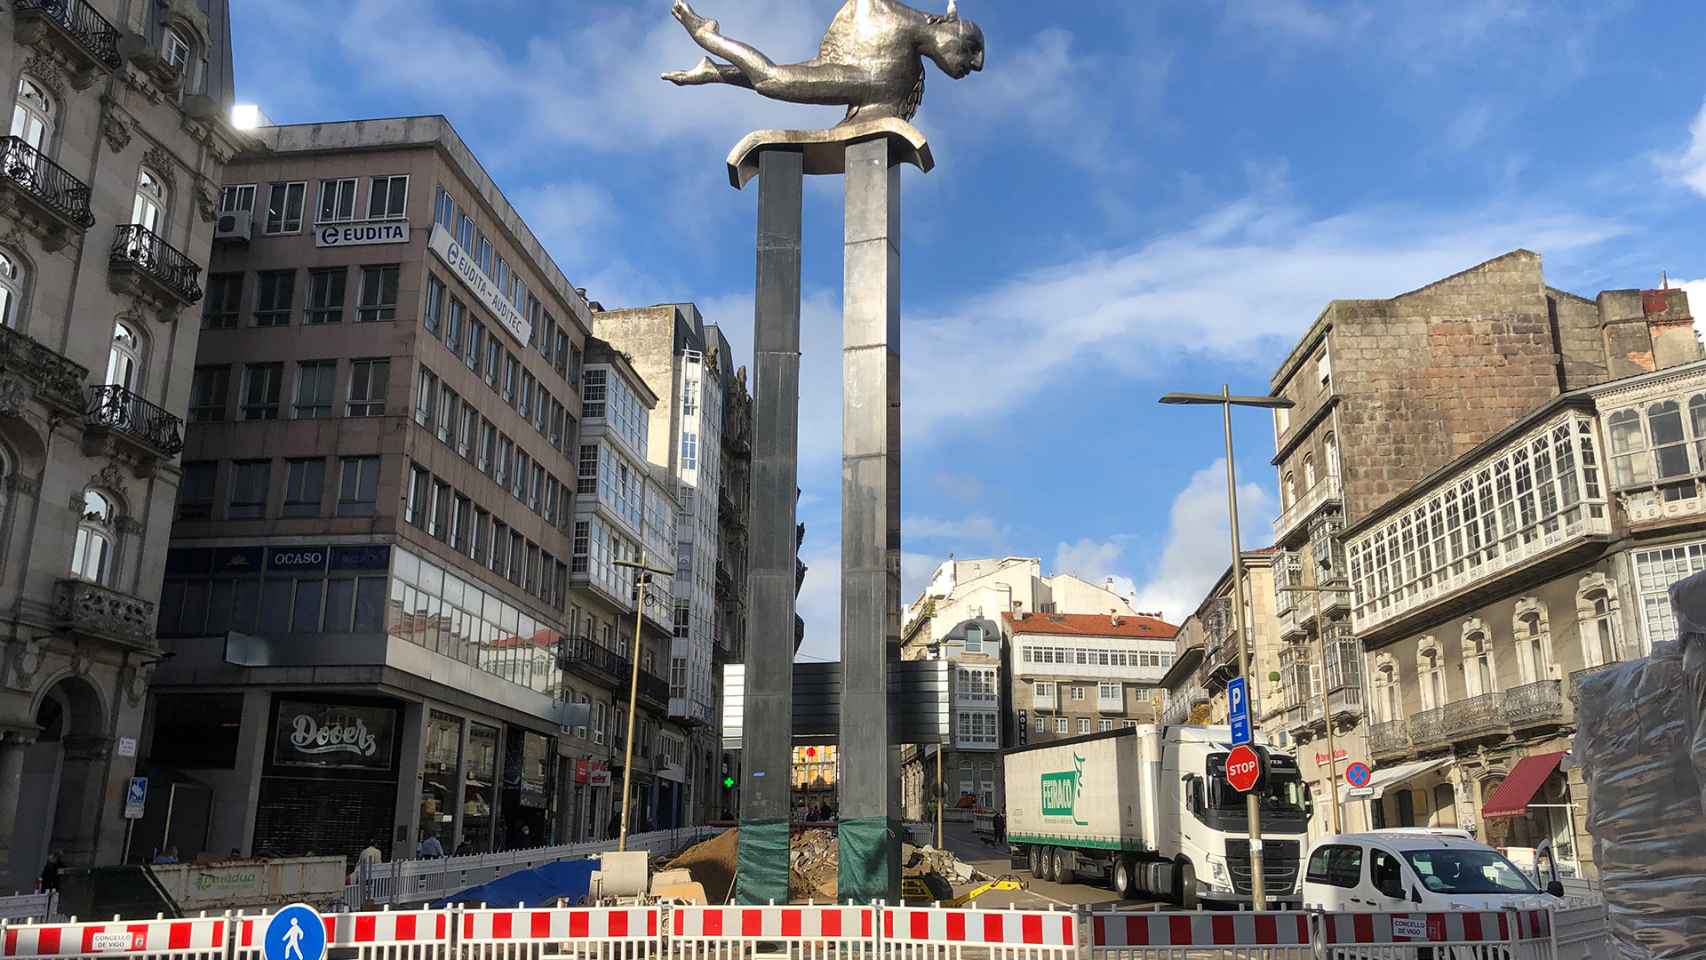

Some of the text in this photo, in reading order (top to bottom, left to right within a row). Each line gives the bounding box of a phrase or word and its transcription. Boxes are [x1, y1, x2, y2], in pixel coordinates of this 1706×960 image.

[343, 226, 404, 241] EUDITA
[459, 256, 487, 296] EUDITA
[491, 294, 523, 334] AUDITEC
[274, 552, 322, 565] OCASO
[1232, 687, 1241, 713] P
[1229, 760, 1256, 777] STOP
